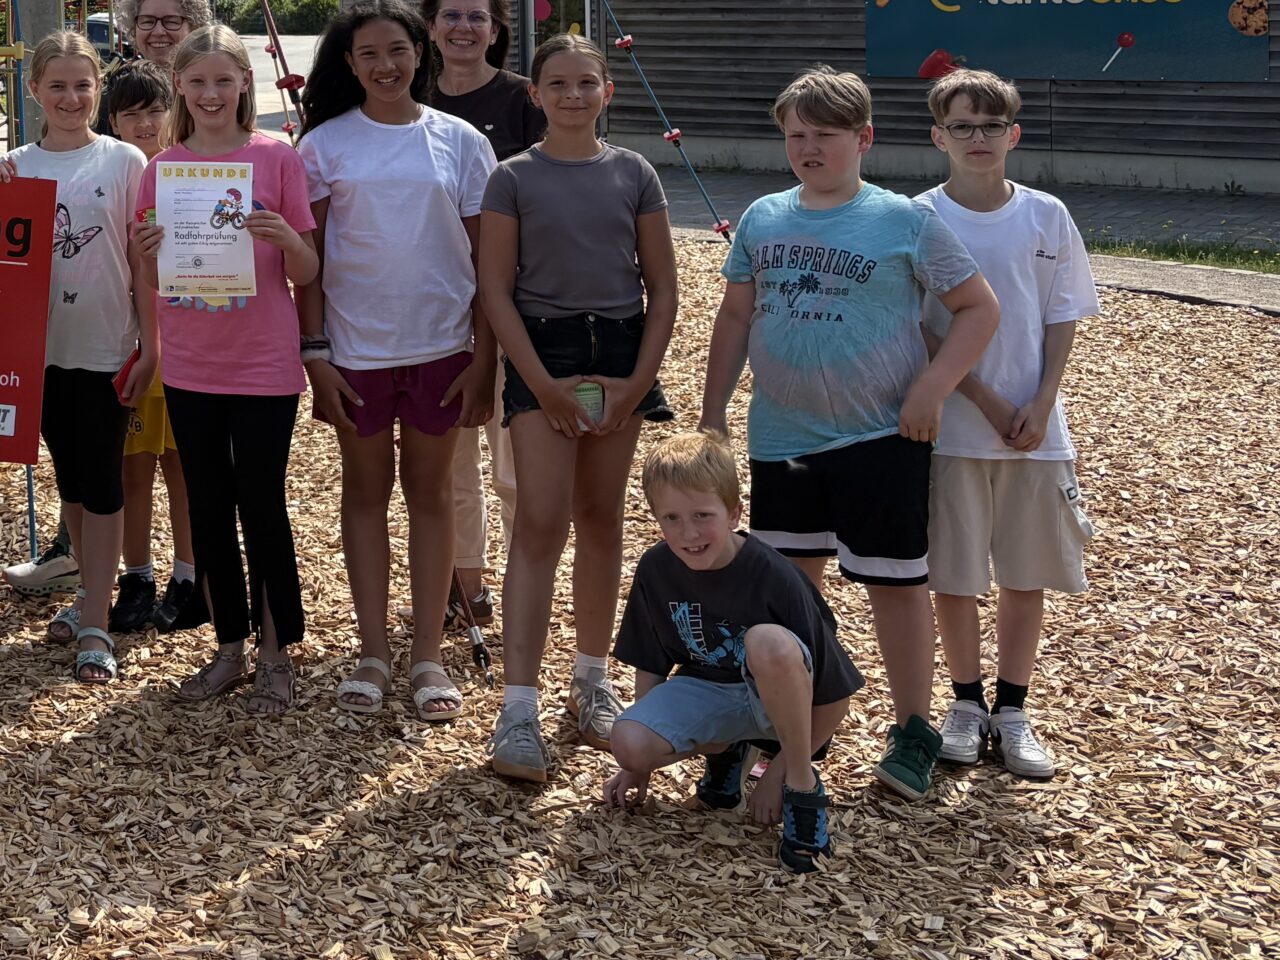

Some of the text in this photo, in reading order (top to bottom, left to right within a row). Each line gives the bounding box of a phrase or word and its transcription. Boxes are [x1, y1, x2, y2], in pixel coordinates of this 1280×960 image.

[162, 167, 248, 179] URKUNDE
[174, 230, 238, 242] Radfahrprüfung
[787, 244, 878, 284] SPRINGS
